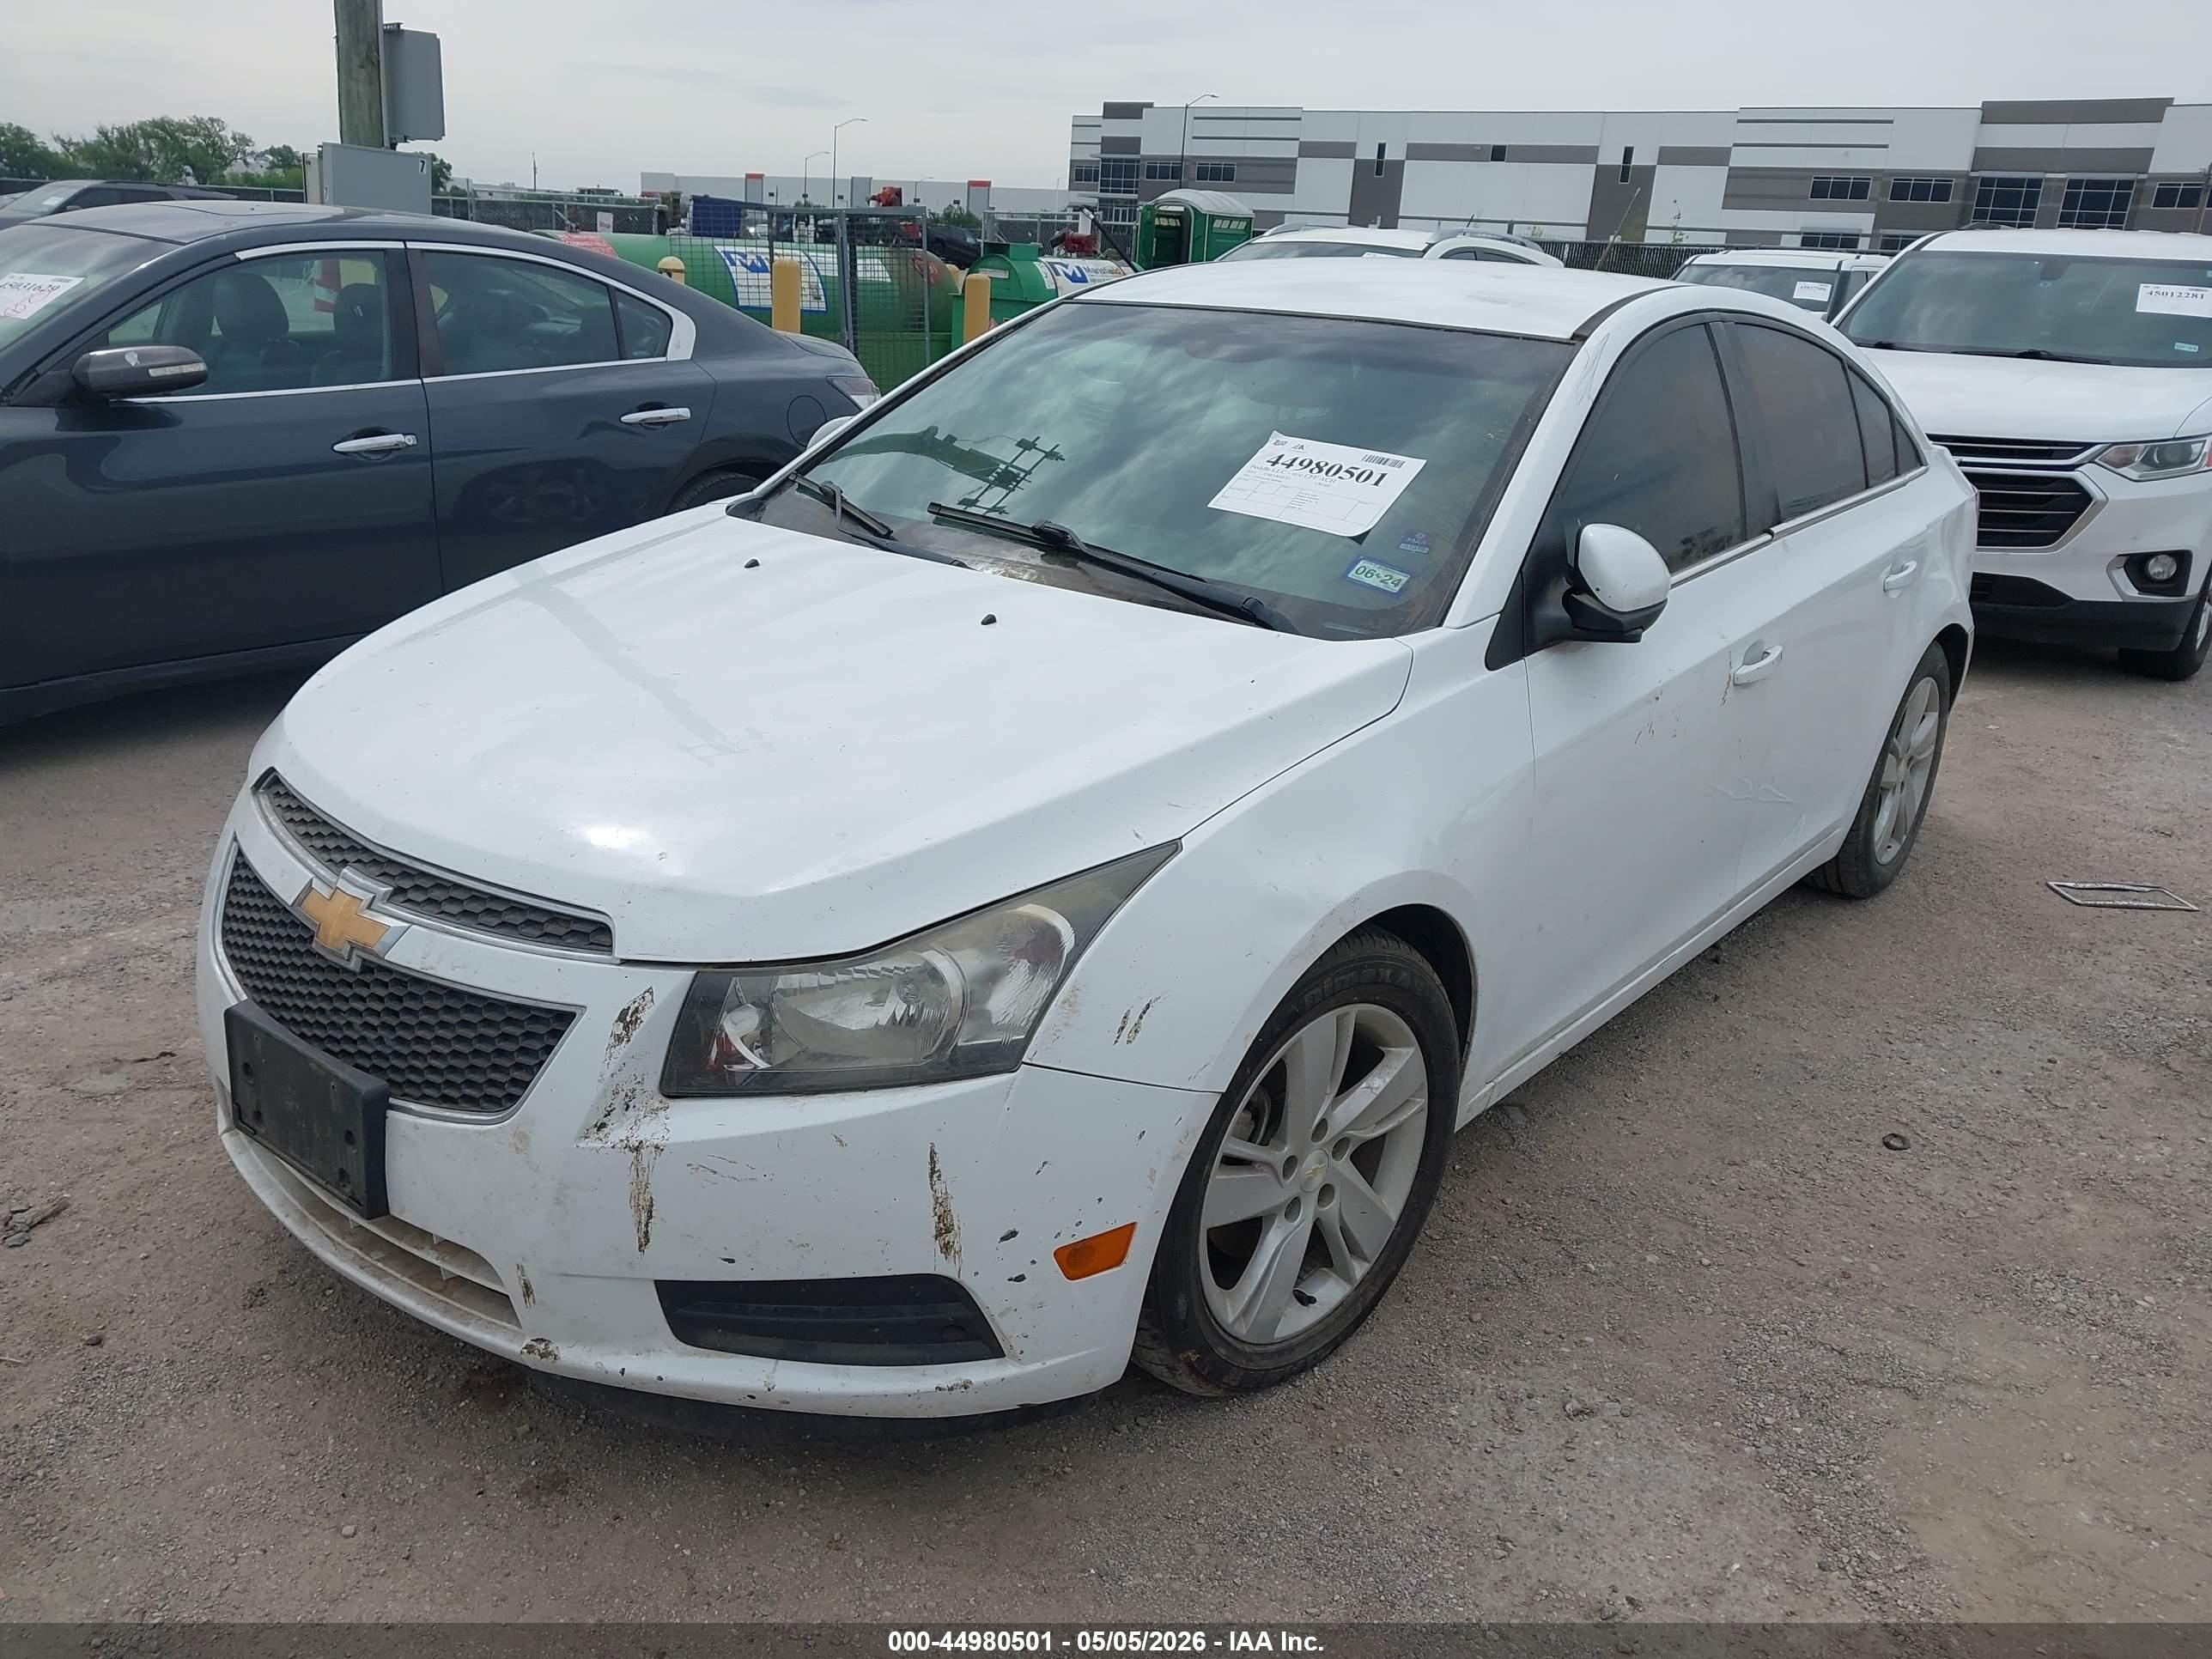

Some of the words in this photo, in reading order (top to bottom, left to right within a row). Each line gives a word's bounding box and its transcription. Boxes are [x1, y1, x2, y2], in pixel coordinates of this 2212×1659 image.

[419, 160, 426, 173] 7
[2147, 290, 2205, 299] 45012281
[1266, 453, 1389, 487] 44980501
